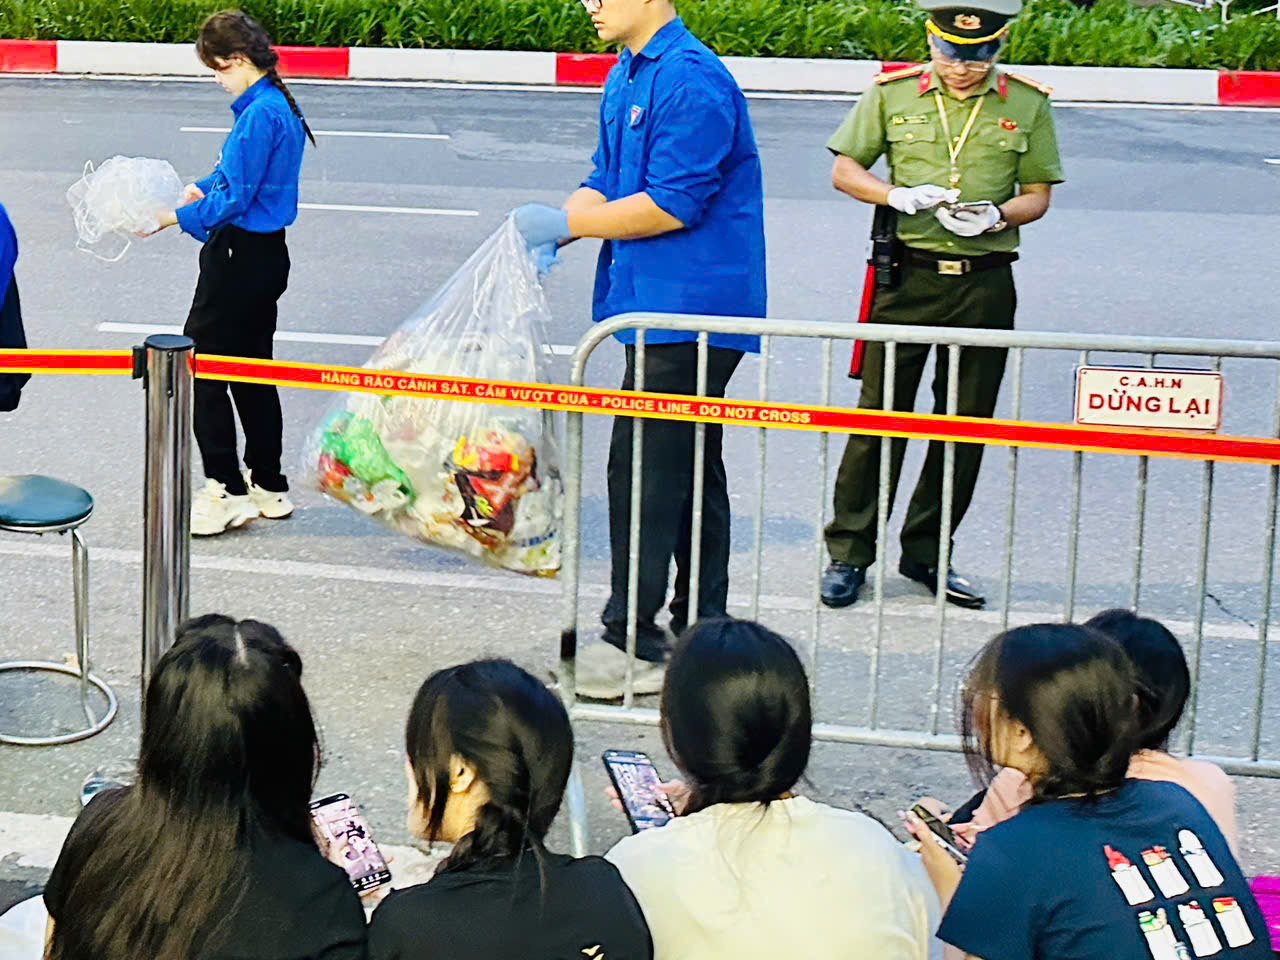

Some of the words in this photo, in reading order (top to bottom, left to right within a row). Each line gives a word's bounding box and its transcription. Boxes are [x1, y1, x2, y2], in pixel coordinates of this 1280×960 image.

[321, 370, 361, 386] HÀNG
[364, 372, 394, 389] RÀO
[557, 393, 590, 406] QUA
[601, 396, 656, 411] POLICE
[699, 404, 722, 417] DO
[724, 406, 756, 419] NOT
[758, 409, 811, 424] CROSS
[1088, 388, 1162, 413] DỪNG
[1168, 397, 1211, 419] LẠI
